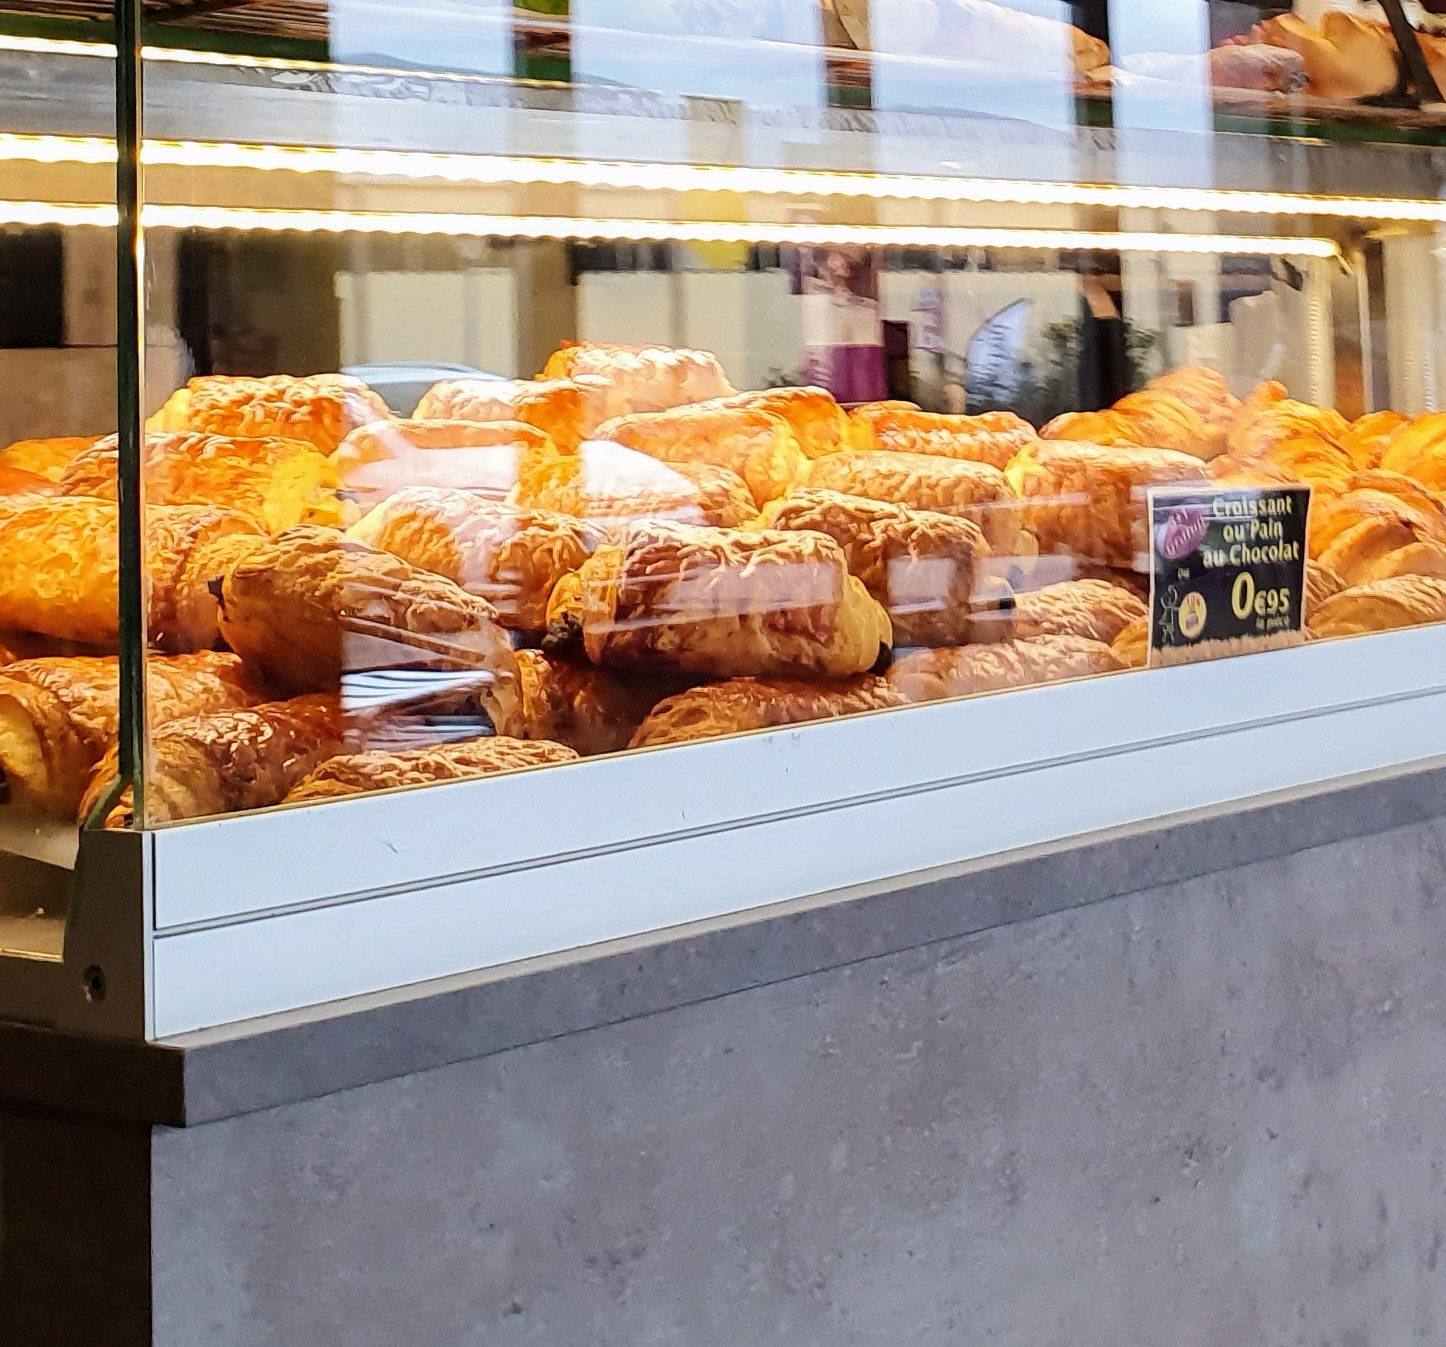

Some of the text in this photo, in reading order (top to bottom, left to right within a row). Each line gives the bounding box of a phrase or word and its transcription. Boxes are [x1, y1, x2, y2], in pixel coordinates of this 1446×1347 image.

[1212, 495, 1293, 517] Croissant
[1223, 518, 1283, 543] ou Pain
[1202, 539, 1300, 569] au Chocolat
